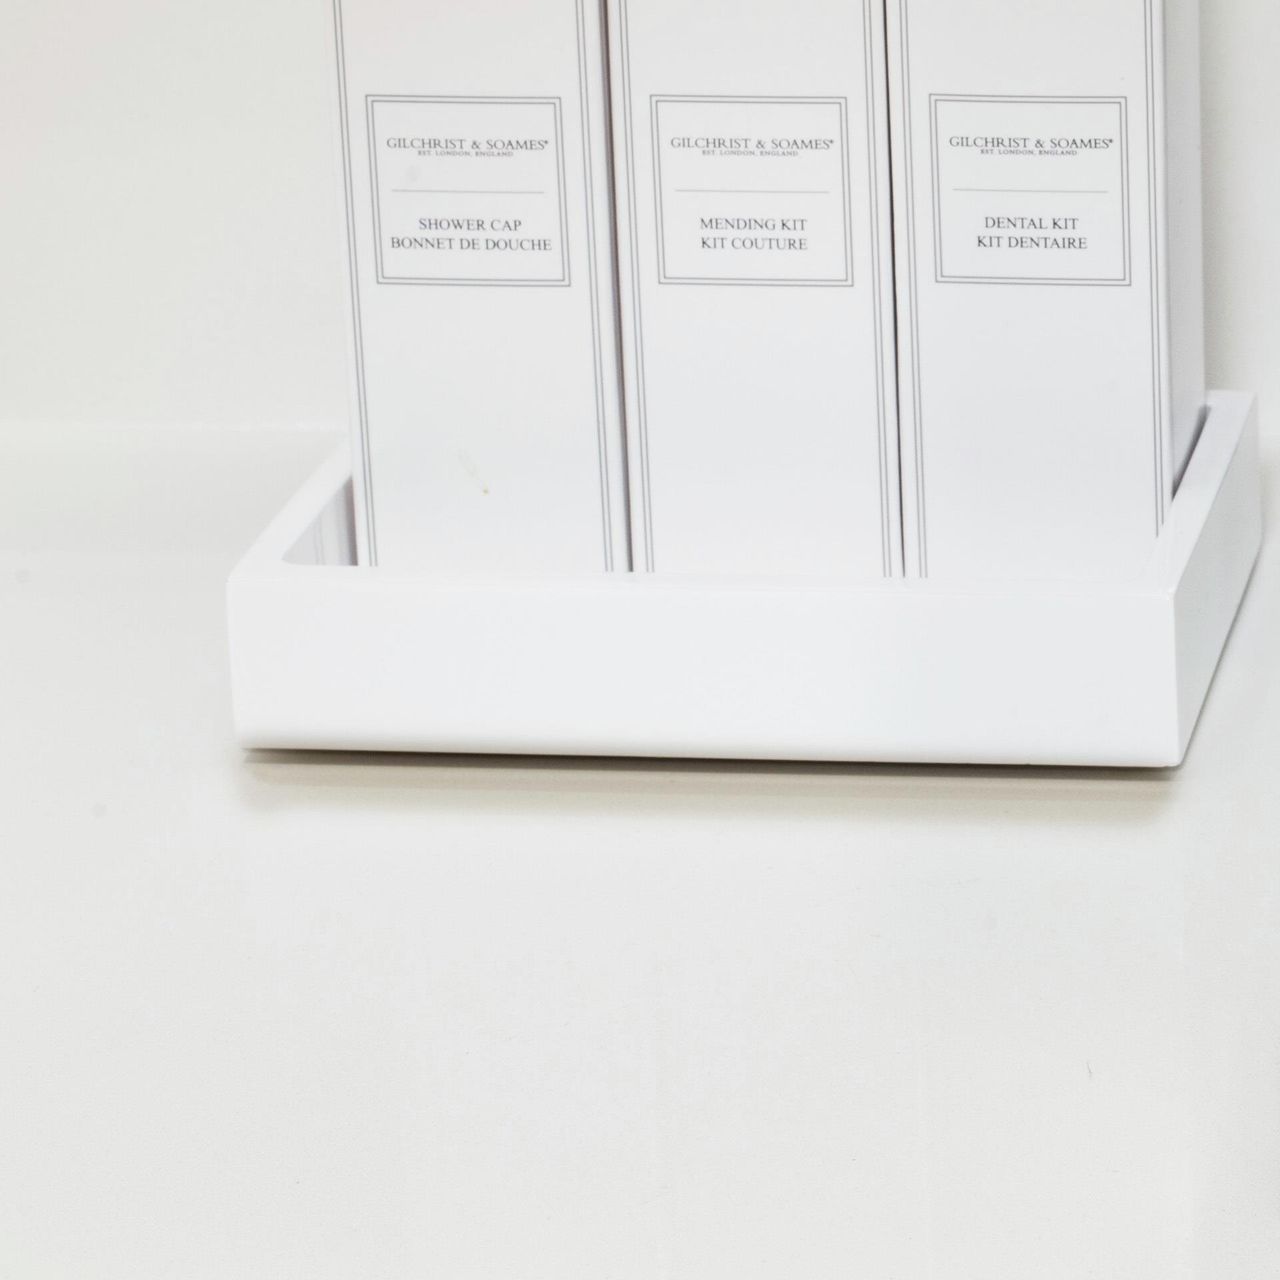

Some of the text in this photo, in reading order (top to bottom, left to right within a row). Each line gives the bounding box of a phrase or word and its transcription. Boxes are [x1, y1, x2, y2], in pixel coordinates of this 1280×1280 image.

[386, 137, 466, 150] GILCHRIST
[470, 140, 481, 150] &
[670, 137, 751, 149] GILCHRIST
[755, 139, 766, 150] &
[948, 136, 1030, 149] GILCHRIST
[1034, 138, 1044, 149] &
[759, 149, 799, 157] ENGLAND
[418, 218, 522, 232] SHOWER CAP
[700, 217, 806, 231] MENDING KIT
[984, 216, 1079, 230] DENTAL KIT
[391, 236, 550, 251] BONNET DE DOUCHE
[701, 236, 806, 251] KIT COUTURE
[977, 235, 1086, 250] KIT DENTAIRE
